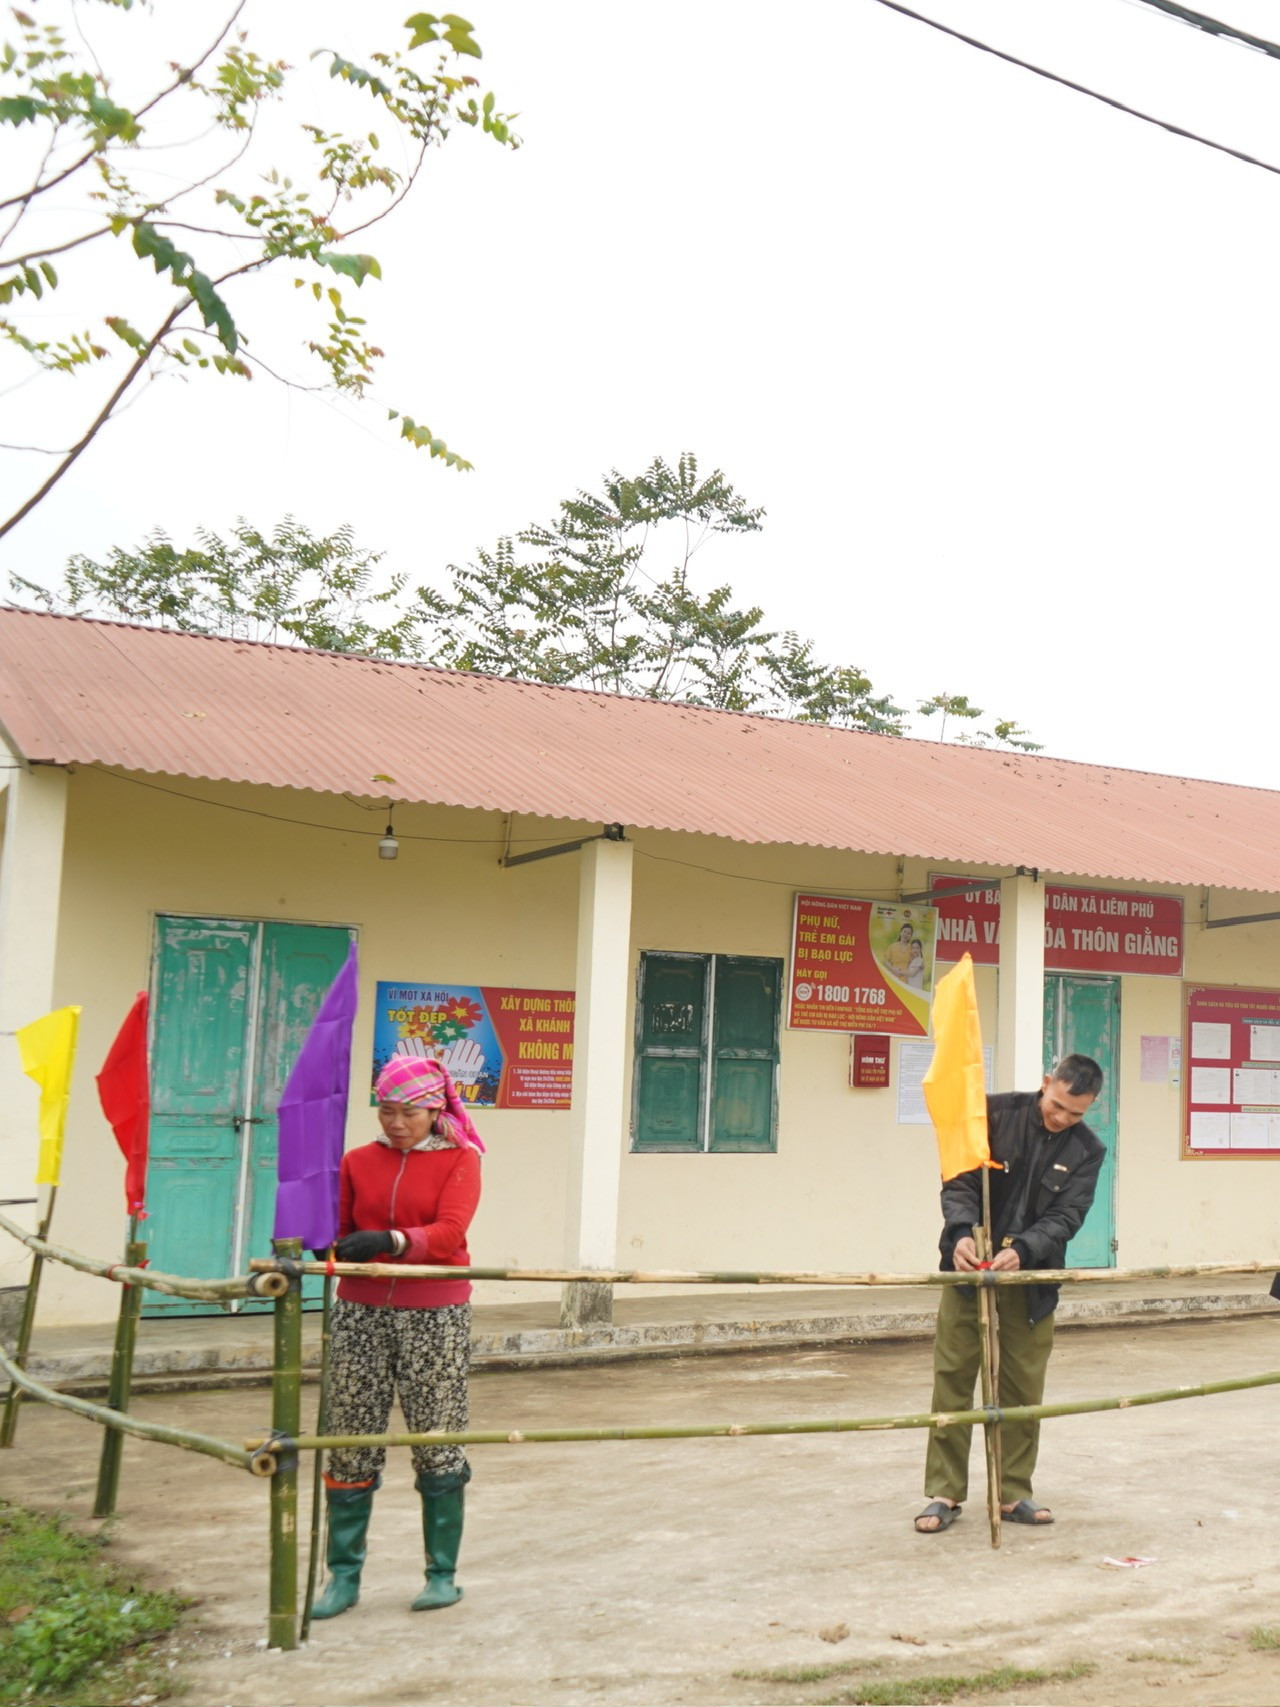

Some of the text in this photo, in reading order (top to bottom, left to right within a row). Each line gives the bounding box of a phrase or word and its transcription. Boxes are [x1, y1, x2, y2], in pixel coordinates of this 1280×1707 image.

[1052, 892, 1077, 911] DÂN
[1081, 896, 1097, 913] XÃ
[1100, 897, 1128, 916] LIÊM
[1131, 900, 1154, 918] PHÚ
[800, 914, 840, 930] PHỤ NỮ,
[799, 929, 855, 946] TRẺ EM GÁI
[937, 915, 978, 943] NHÀ
[1071, 926, 1119, 953] THÔN
[1124, 926, 1178, 957] GIẰNG
[798, 947, 853, 964] BỊ BẠO LỰC
[814, 971, 828, 981] GỌI
[434, 990, 449, 1004] HỘI
[817, 984, 850, 1002] 1800
[854, 987, 886, 1005] 1768
[501, 995, 521, 1010] XÂY
[523, 997, 551, 1014] DỰNG
[387, 1006, 415, 1022] TỐT
[519, 1016, 570, 1032] XÃ KHÁNH
[519, 1039, 559, 1060] KHÔNG
